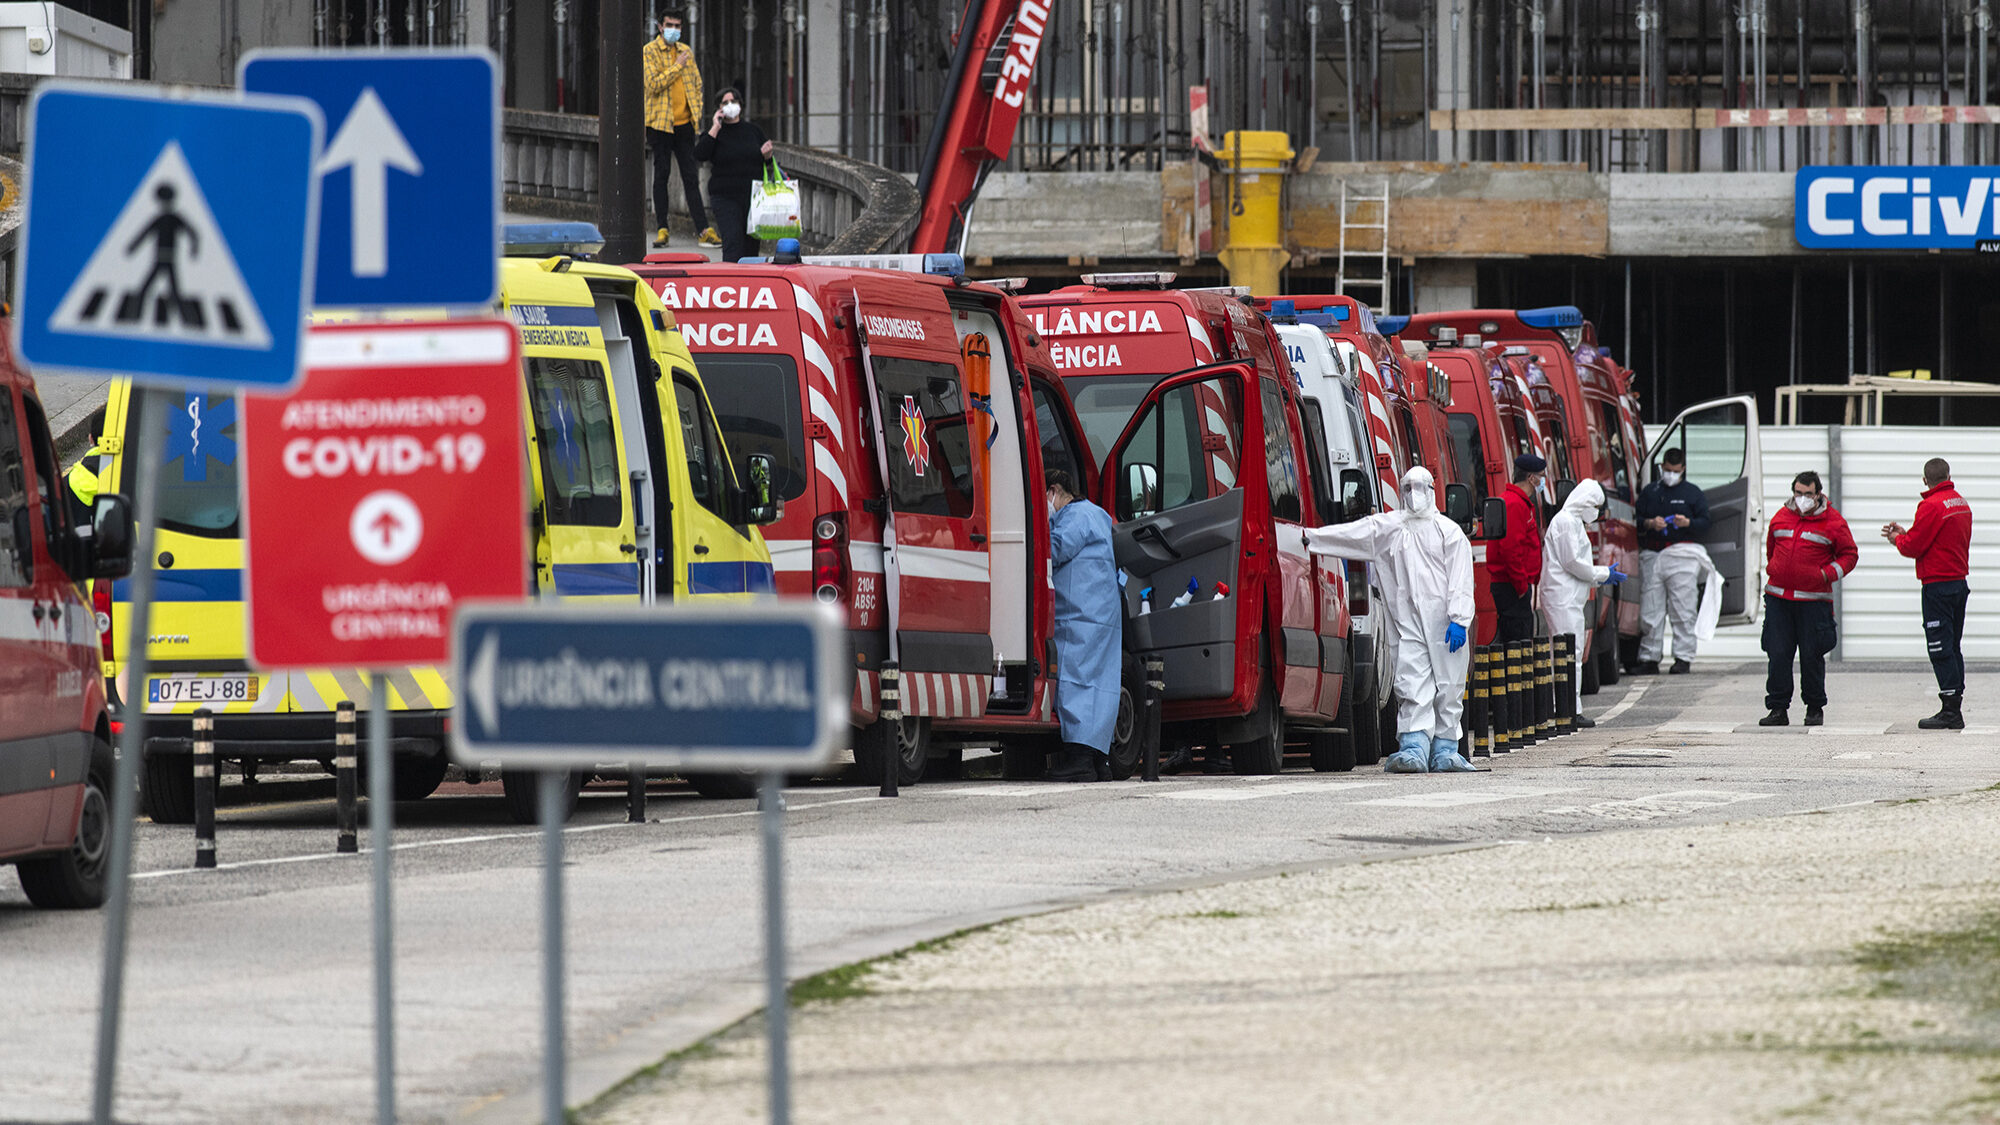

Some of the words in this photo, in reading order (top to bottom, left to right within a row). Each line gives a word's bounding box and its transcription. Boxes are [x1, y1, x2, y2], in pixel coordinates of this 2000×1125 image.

[995, 0, 1053, 108] TRAN
[1980, 243, 2000, 253] ALV
[523, 327, 565, 345] EMERGÊNCIA
[565, 328, 591, 346] MÉDICA
[676, 323, 778, 346] NCIA
[864, 315, 925, 341] LISBONENSES
[281, 395, 486, 430] ATENDIMENTO
[282, 432, 486, 478] COVID-19
[322, 580, 453, 613] URGÊNCIA
[857, 577, 875, 593] 2104
[855, 594, 876, 610] ABSC
[331, 612, 446, 641] CENTRAL
[860, 611, 869, 627] 10
[145, 634, 190, 645] AFTER
[500, 648, 654, 709] URGÊNCIA
[659, 658, 811, 710] CENTRAL
